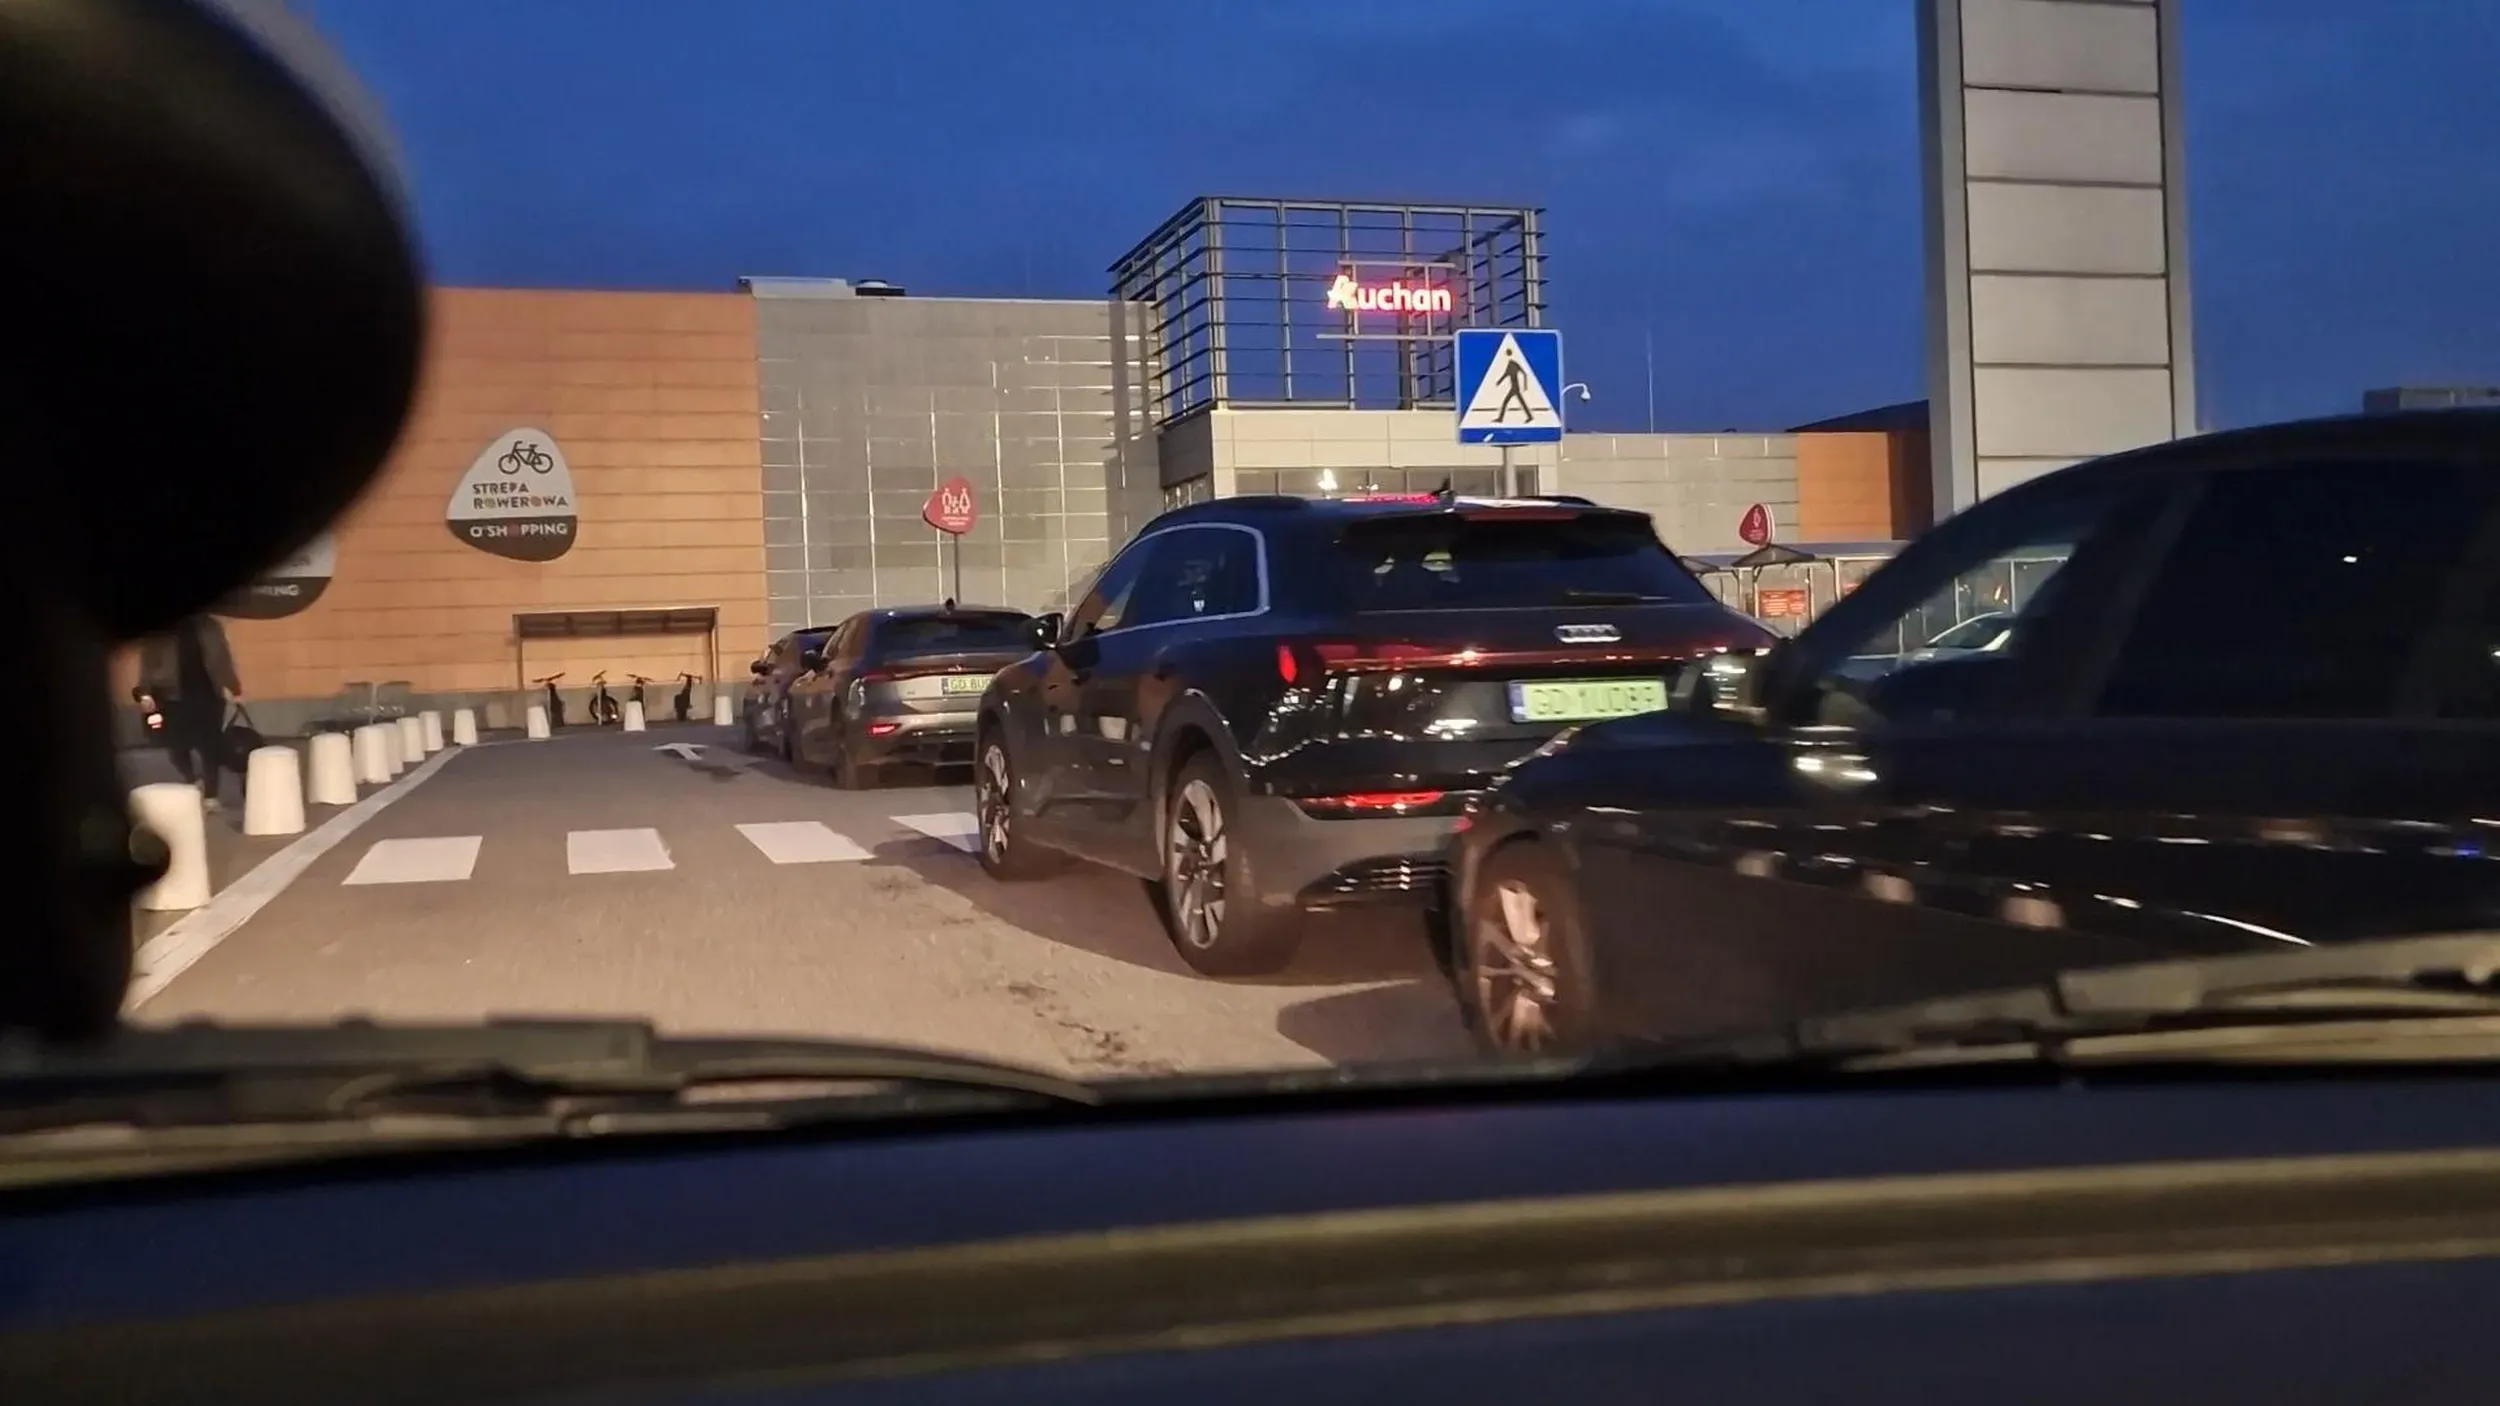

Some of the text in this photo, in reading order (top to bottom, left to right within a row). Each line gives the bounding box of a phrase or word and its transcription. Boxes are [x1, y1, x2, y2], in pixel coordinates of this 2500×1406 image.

[1326, 274, 1452, 311] Auchan
[473, 495, 569, 509] ROWEROWA
[1531, 688, 1567, 715] GD
